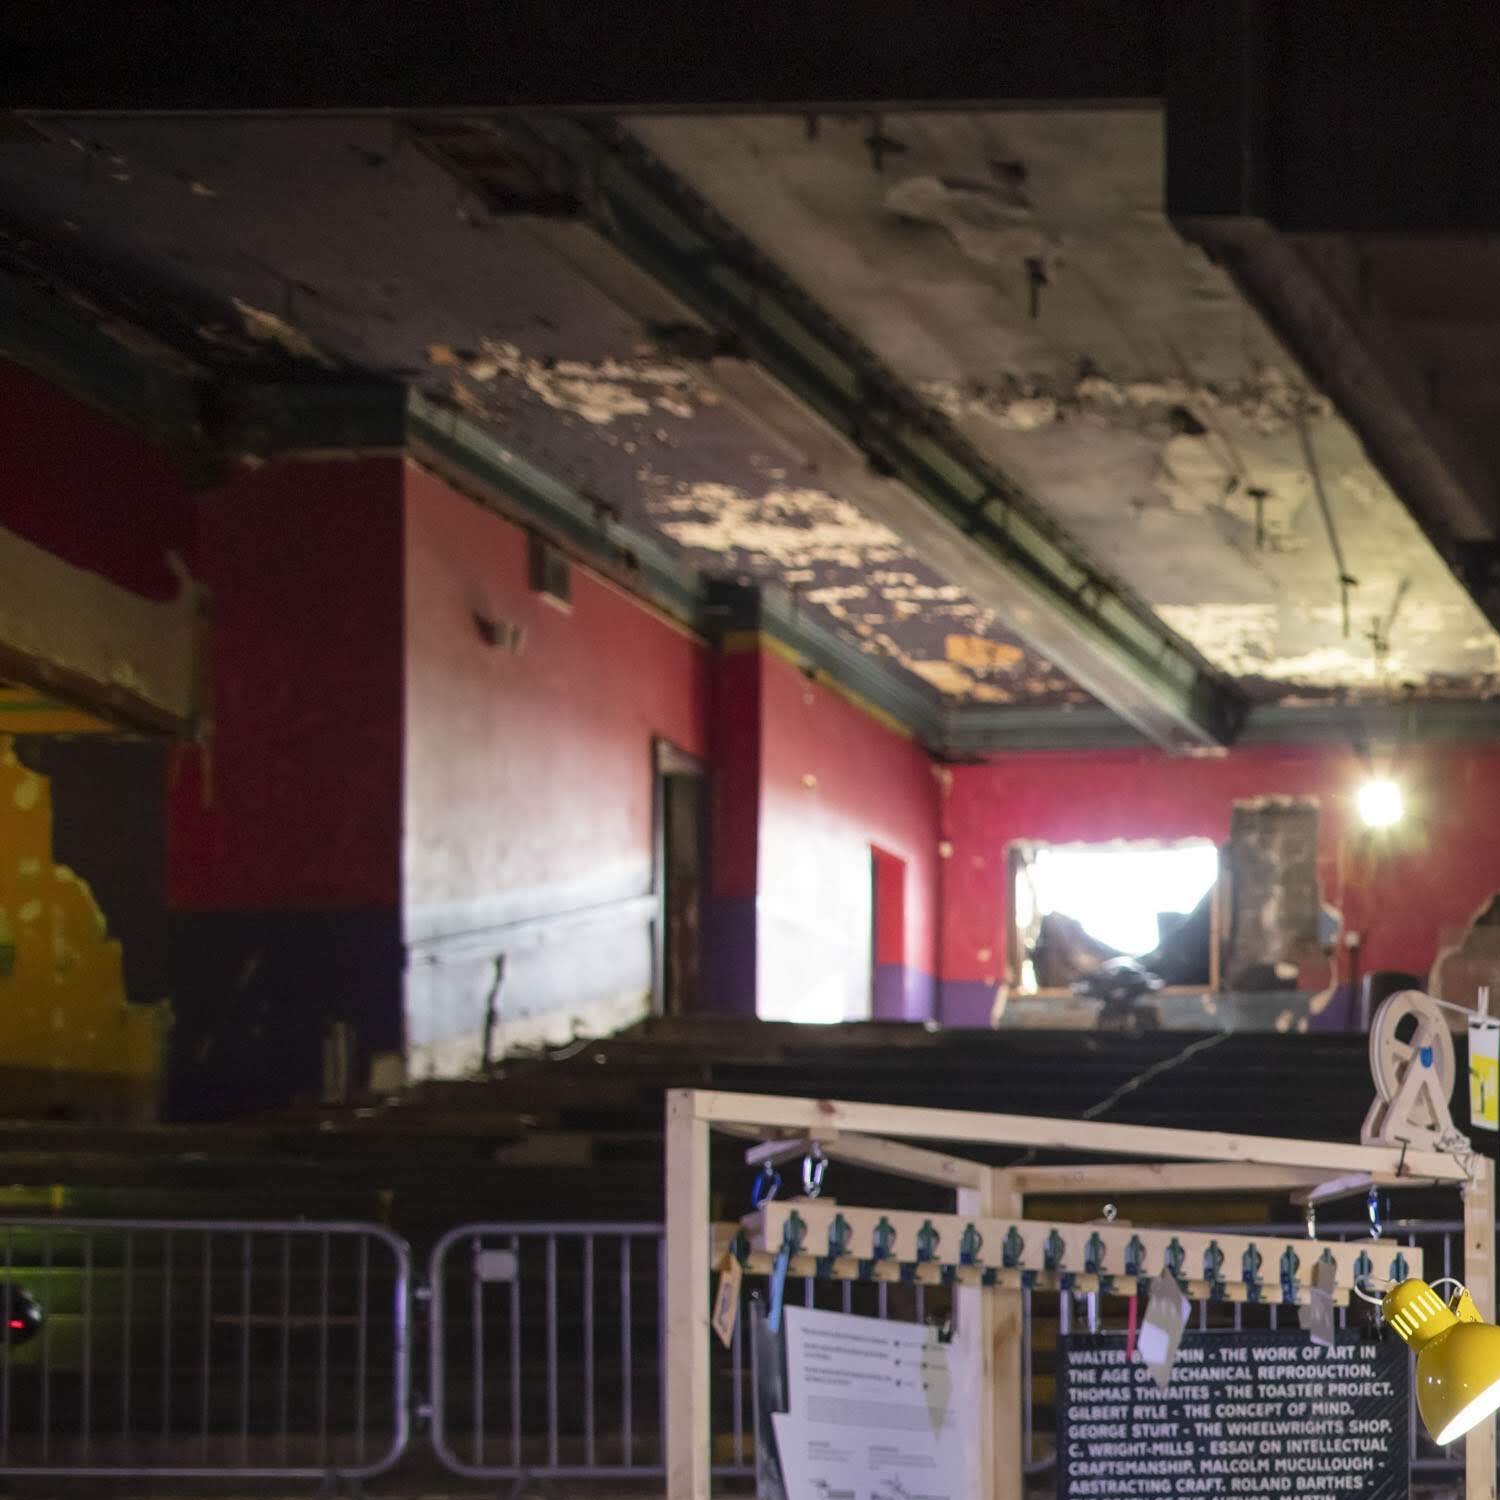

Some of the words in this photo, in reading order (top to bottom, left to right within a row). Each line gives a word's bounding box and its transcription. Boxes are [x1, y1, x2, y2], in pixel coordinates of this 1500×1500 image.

[1068, 1349, 1126, 1364] WALTER
[1132, 1349, 1204, 1363] BMIN
[1219, 1347, 1247, 1361] THE
[1253, 1347, 1297, 1360] WORK
[1302, 1346, 1321, 1359] OF
[1326, 1346, 1356, 1358] ART
[1360, 1345, 1377, 1358] IN
[1069, 1369, 1096, 1383] THE
[1101, 1369, 1130, 1382] AGE
[1160, 1366, 1252, 1382] ECHANICAL
[1258, 1364, 1376, 1379] REPRODUCTION.
[1069, 1388, 1131, 1401] THOMAS
[1135, 1386, 1209, 1400] THWAITES
[1225, 1384, 1253, 1398] THE
[1258, 1383, 1323, 1398] TOASTER
[1328, 1382, 1395, 1396] PROJECT.
[1068, 1406, 1128, 1420] GILBERT
[1133, 1405, 1168, 1419] RYLE
[1183, 1405, 1211, 1418] THE
[1215, 1402, 1282, 1418] CONCEPT
[1287, 1402, 1307, 1416] OF
[1311, 1402, 1355, 1415] MIND.
[1068, 1424, 1127, 1439] GEORGE
[1132, 1423, 1178, 1438] STURT
[1194, 1423, 1222, 1436] THE
[1226, 1421, 1344, 1436] WHEELWRIGHTS
[1349, 1420, 1392, 1433] SHOP.
[1068, 1443, 1084, 1457] C.
[1088, 1442, 1194, 1457] WRIGHT-MILLS
[1210, 1440, 1253, 1455] ESSAY
[1259, 1440, 1281, 1453] ON
[1287, 1438, 1388, 1452] INTELLECTUAL
[1068, 1461, 1195, 1476] CRAFTSMANSHIP.
[1200, 1459, 1270, 1474] MALCOLM
[1275, 1458, 1373, 1472] MUCULLOUGH
[1068, 1479, 1171, 1494] ABSTRACTING
[1176, 1478, 1226, 1492] CRAFT.
[1232, 1477, 1291, 1492] ROLAND
[1296, 1476, 1363, 1490] BARTHES
